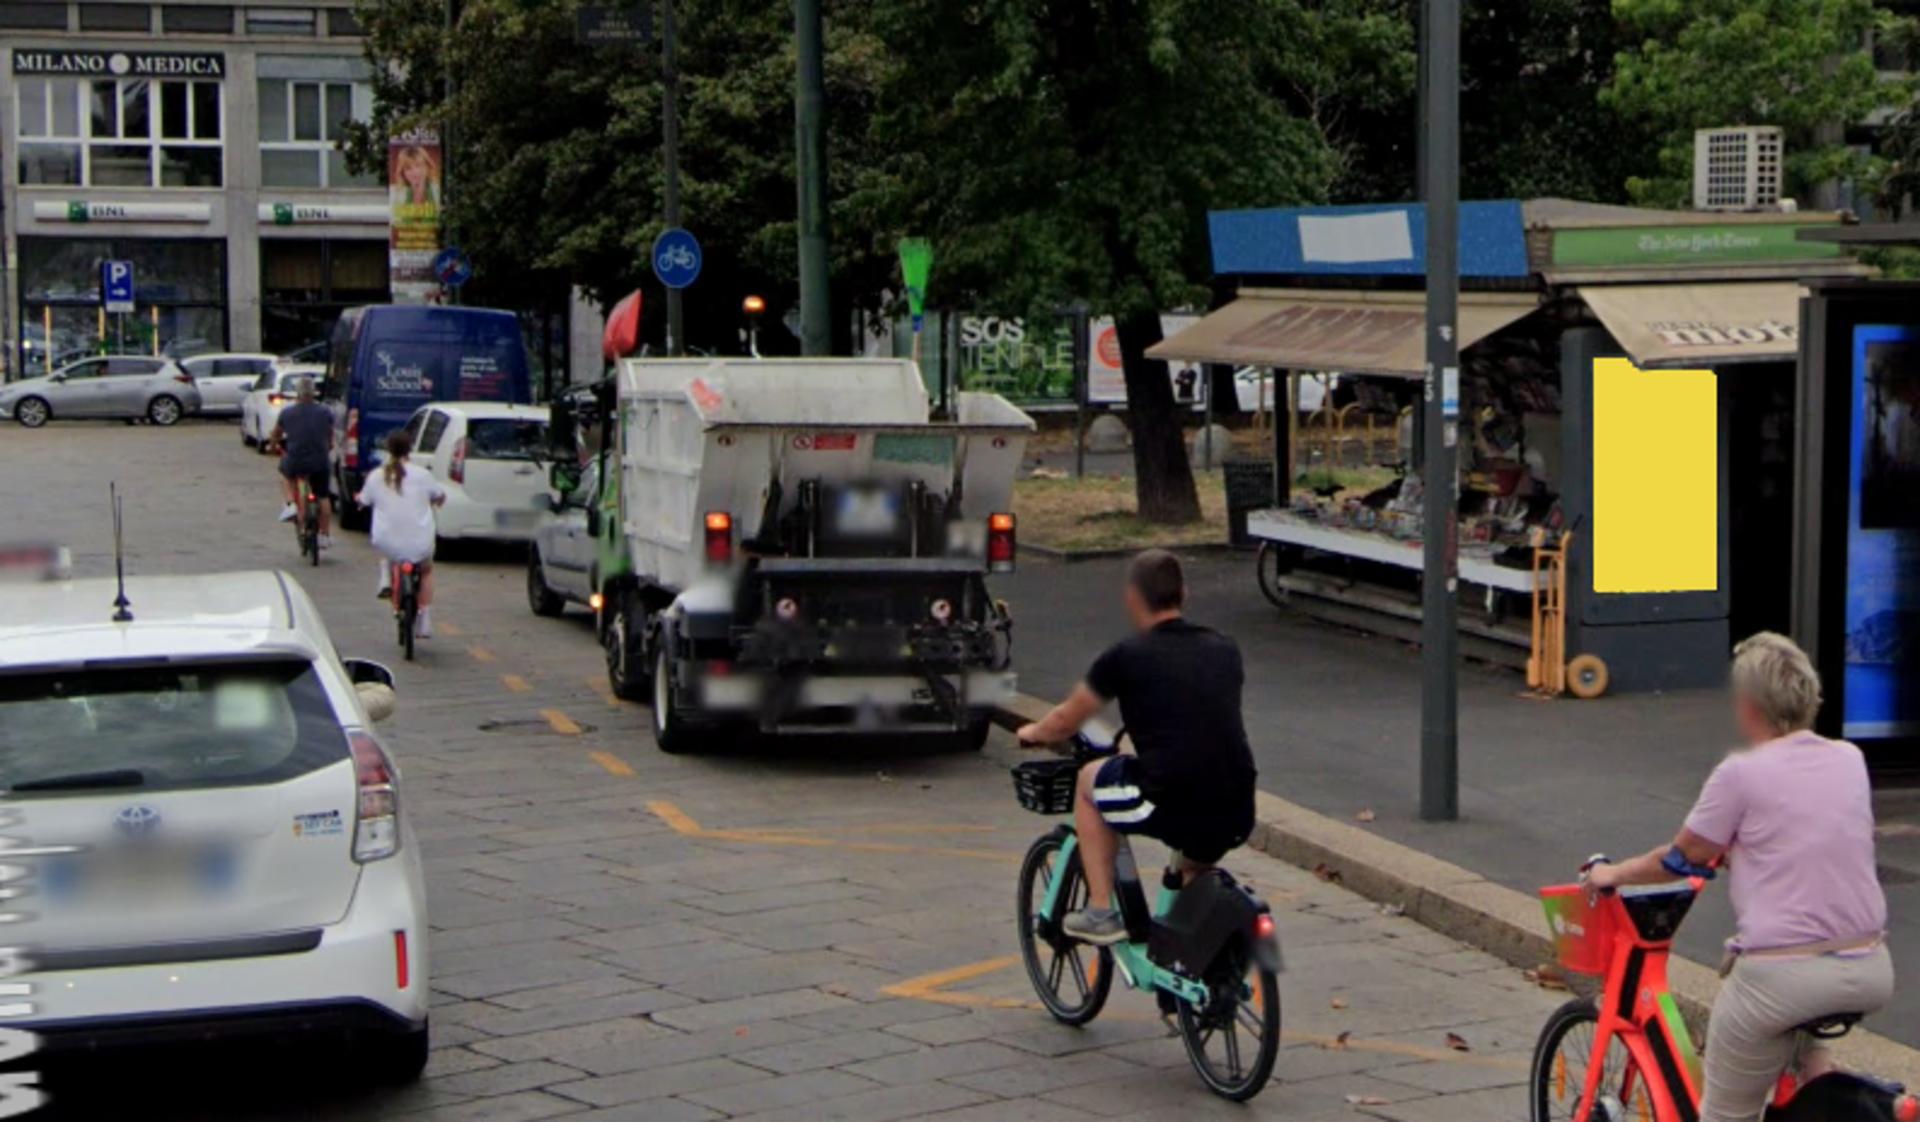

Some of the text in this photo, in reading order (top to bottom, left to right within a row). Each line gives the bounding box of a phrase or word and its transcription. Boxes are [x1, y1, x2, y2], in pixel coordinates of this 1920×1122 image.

[16, 53, 221, 74] MILANO MEDICA
[111, 262, 128, 283] P
[961, 316, 1026, 343] SOS
